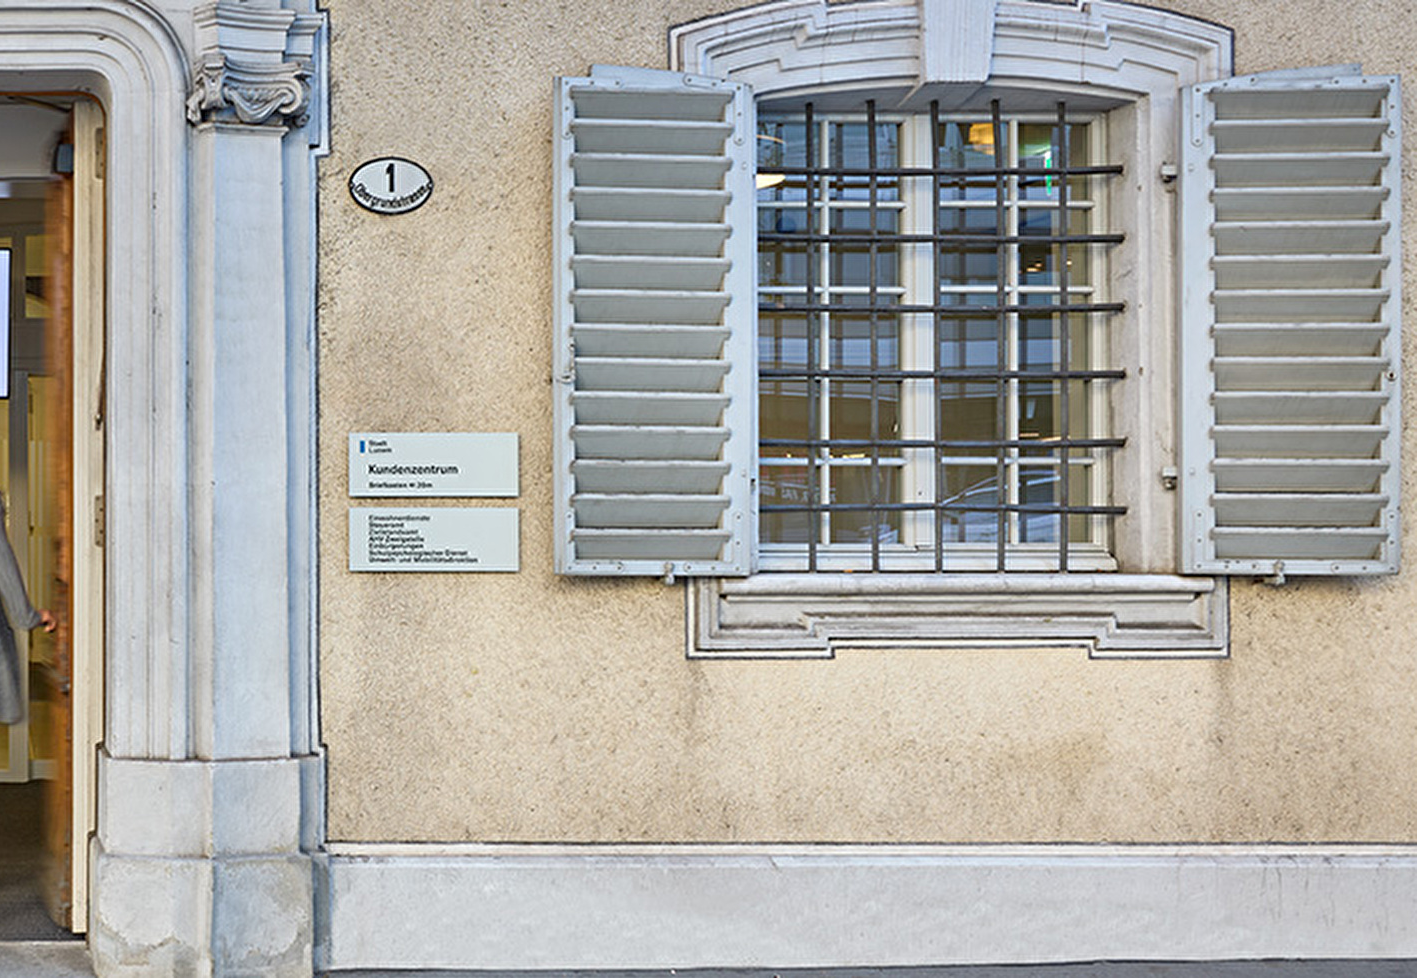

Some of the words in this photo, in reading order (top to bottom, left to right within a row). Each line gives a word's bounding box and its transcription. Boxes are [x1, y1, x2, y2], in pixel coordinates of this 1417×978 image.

[386, 163, 394, 192] 1
[354, 183, 428, 208] Obergrundstrasse
[368, 464, 459, 475] Kundenzentrum
